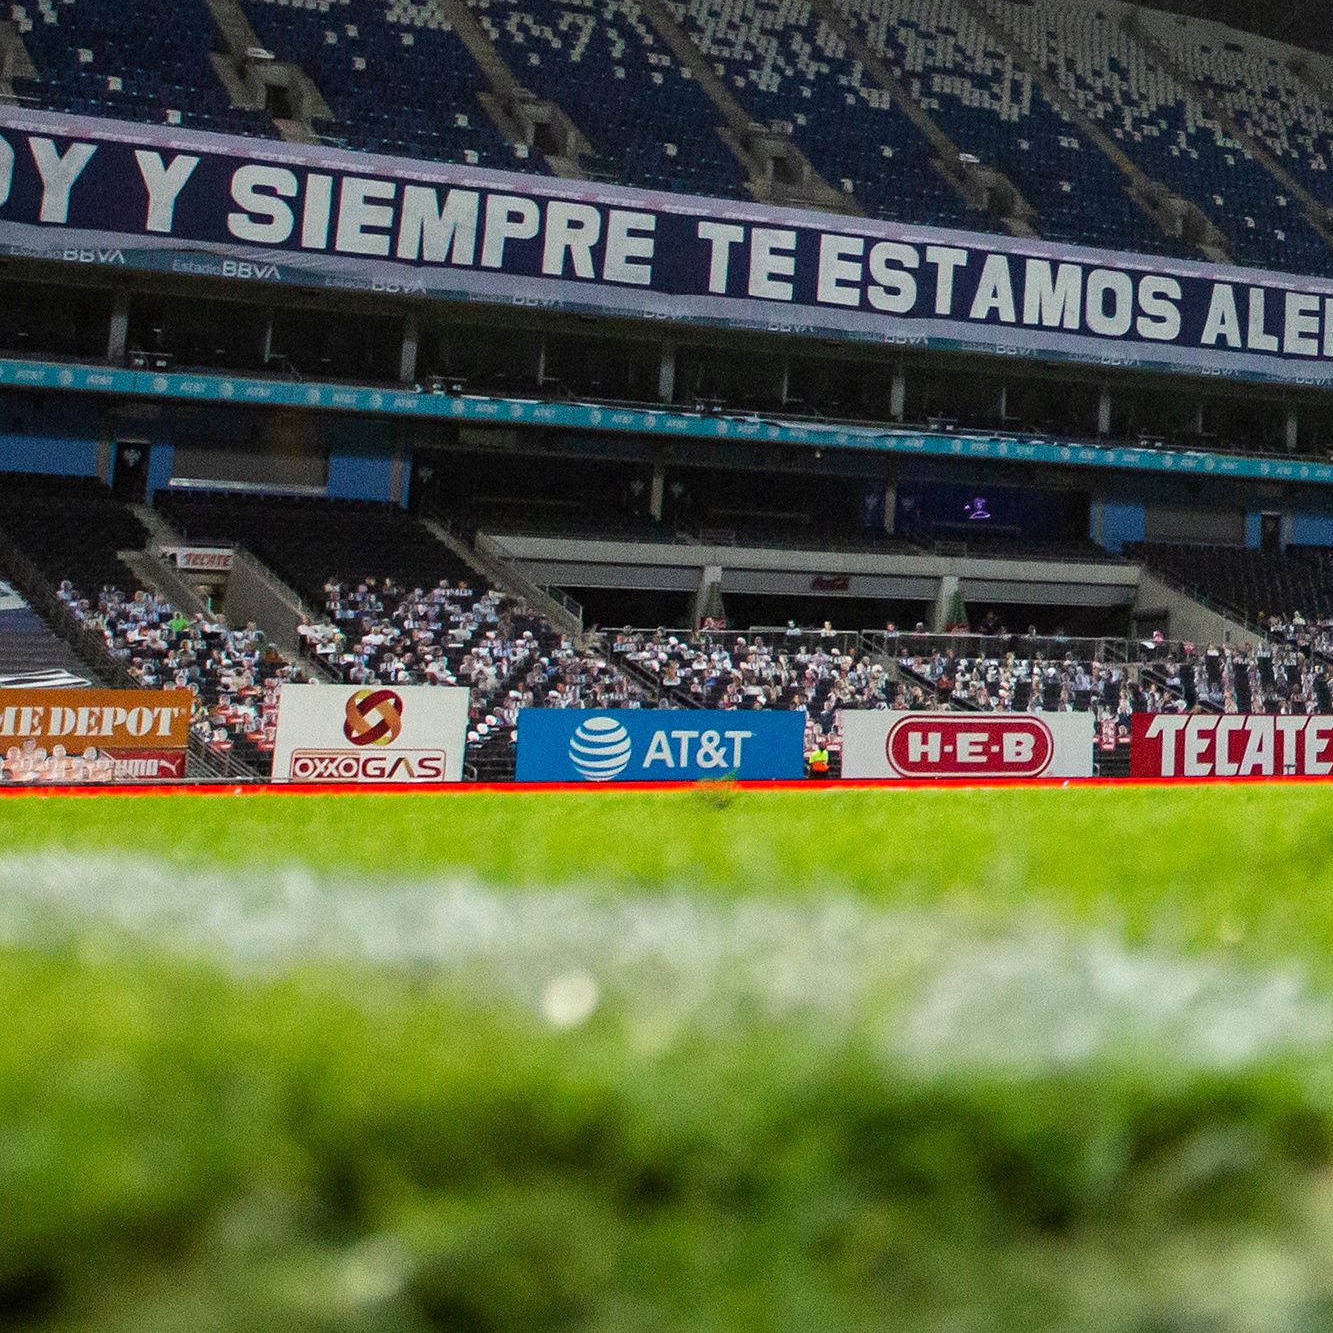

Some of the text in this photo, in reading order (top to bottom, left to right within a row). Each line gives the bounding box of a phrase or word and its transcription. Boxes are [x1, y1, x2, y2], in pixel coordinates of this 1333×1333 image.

[0, 131, 98, 224] Y
[135, 149, 200, 233] Y
[227, 164, 657, 286] SIEMPRE
[697, 220, 798, 302] TE
[816, 232, 1184, 341] ESTAMOS
[222, 260, 281, 280] BBVA
[47, 706, 179, 737] DEPOT
[642, 730, 752, 768] AT&T
[907, 731, 1036, 764] H-E-B
